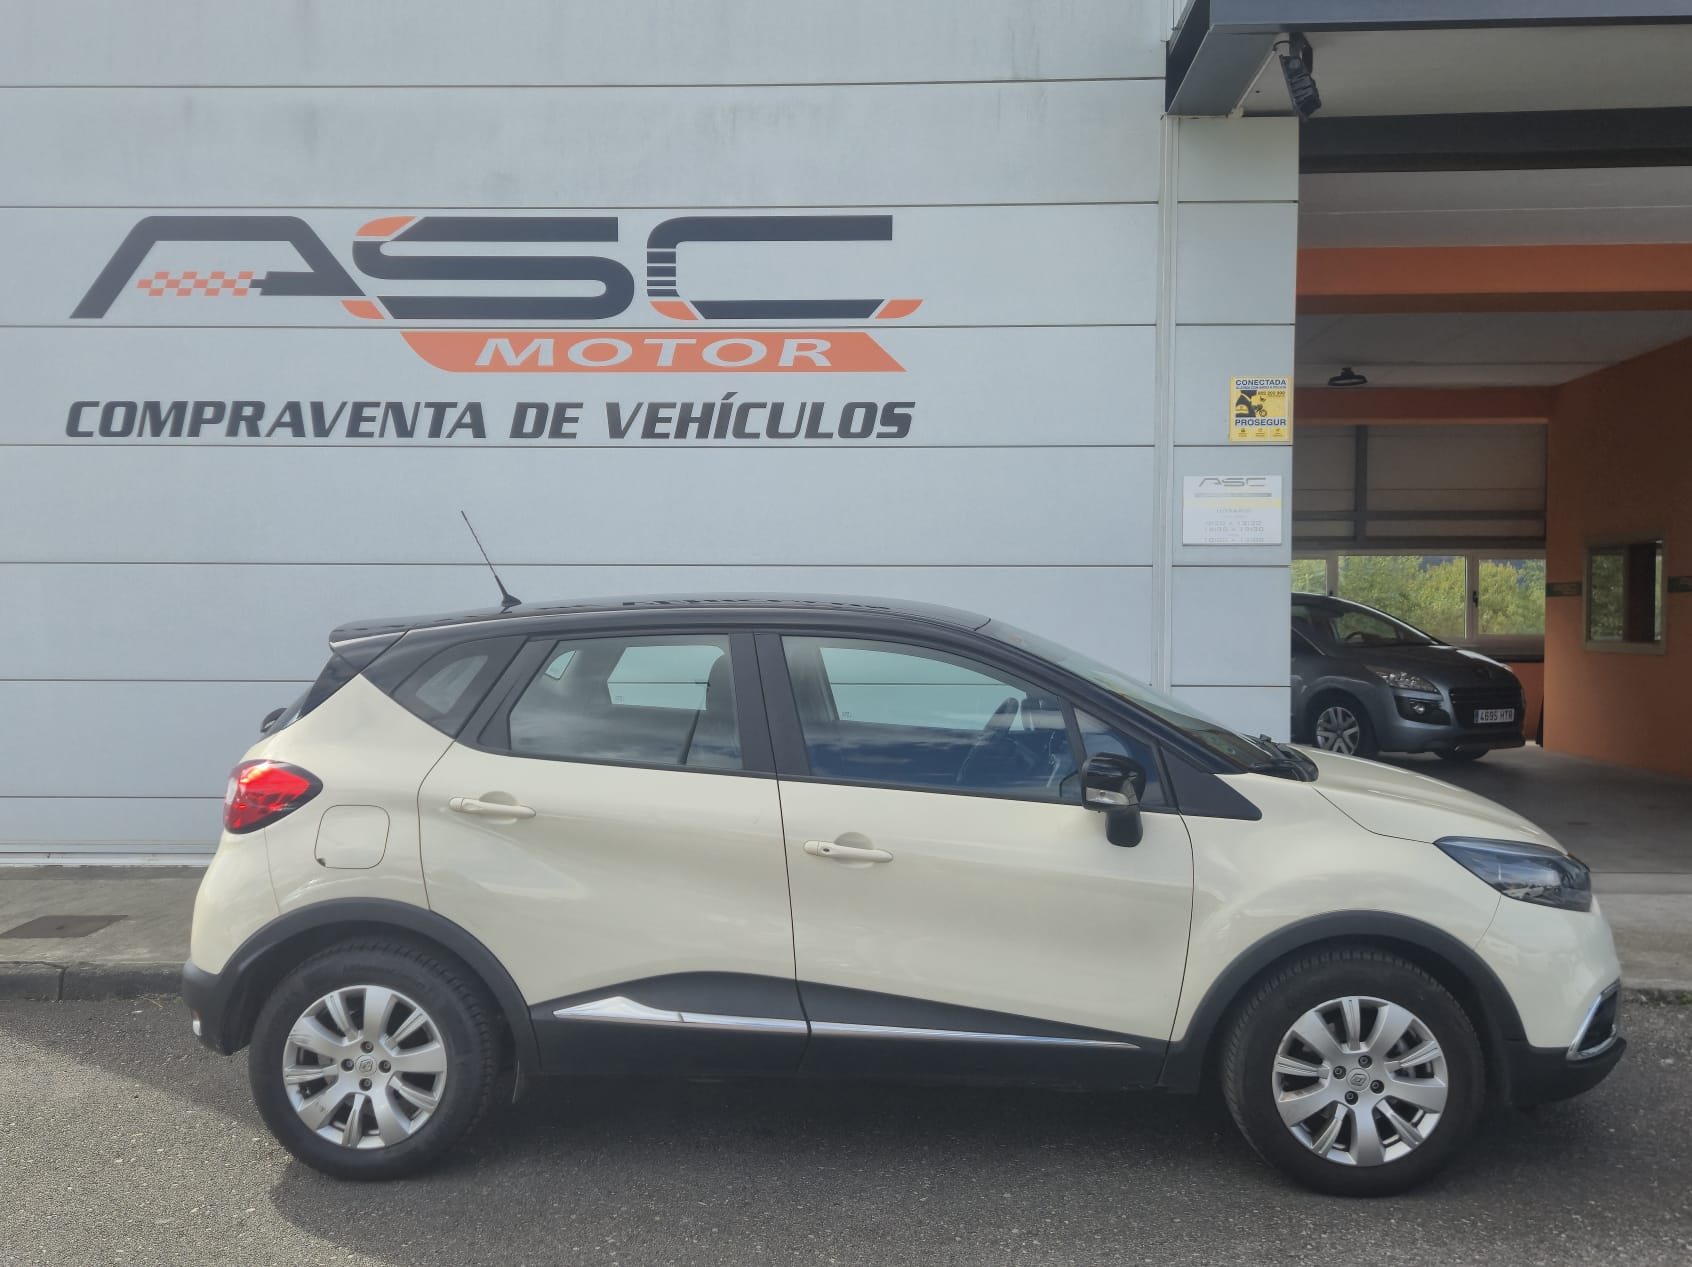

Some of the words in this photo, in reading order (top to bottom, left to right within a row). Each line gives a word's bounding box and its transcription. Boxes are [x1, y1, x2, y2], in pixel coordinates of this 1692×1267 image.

[70, 214, 924, 321] ASC
[474, 337, 835, 368] MOTOR
[64, 401, 488, 439] COMPRAVENTA
[510, 402, 584, 439] DE
[605, 392, 917, 440] VEHÍCULOS
[1235, 418, 1287, 427] PROSEGUR
[1198, 477, 1267, 488] ASC
